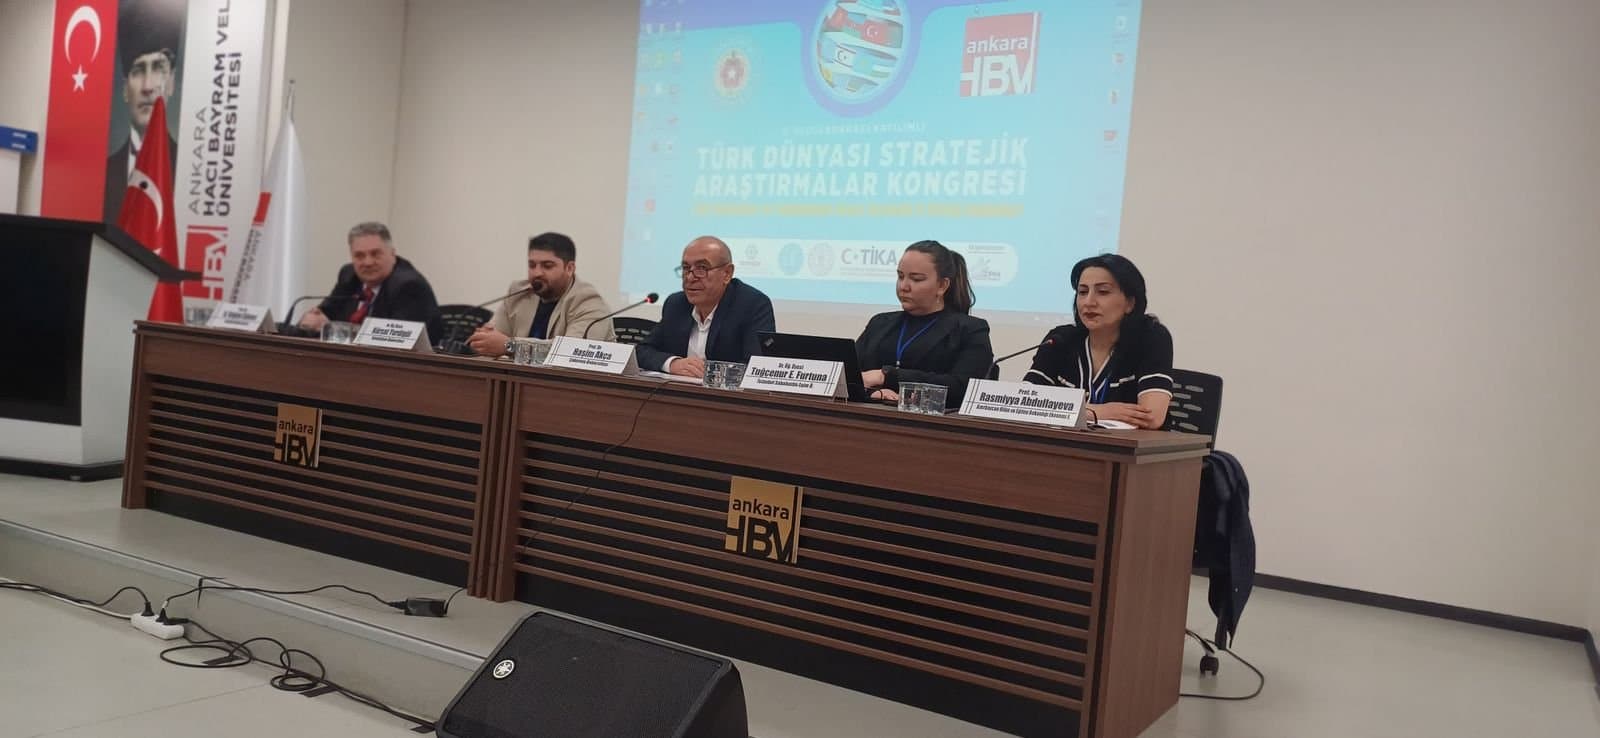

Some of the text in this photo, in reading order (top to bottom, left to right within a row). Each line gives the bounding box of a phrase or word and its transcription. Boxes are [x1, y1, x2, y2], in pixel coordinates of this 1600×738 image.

[966, 34, 1029, 54] ankara
[208, 53, 225, 153] BAYRAM
[216, 51, 242, 217] ÜNİVERSİTESİ
[187, 106, 207, 215] ANKARA
[696, 133, 1029, 170] TÜRK DÜNYASI STRATEJİK
[203, 160, 218, 217] HACI
[693, 172, 879, 200] ARAŞTIRMALAR
[980, 391, 1074, 412] Rasmiyya Abdullayeva
[279, 419, 314, 435] ankara
[732, 498, 790, 520] ankara
